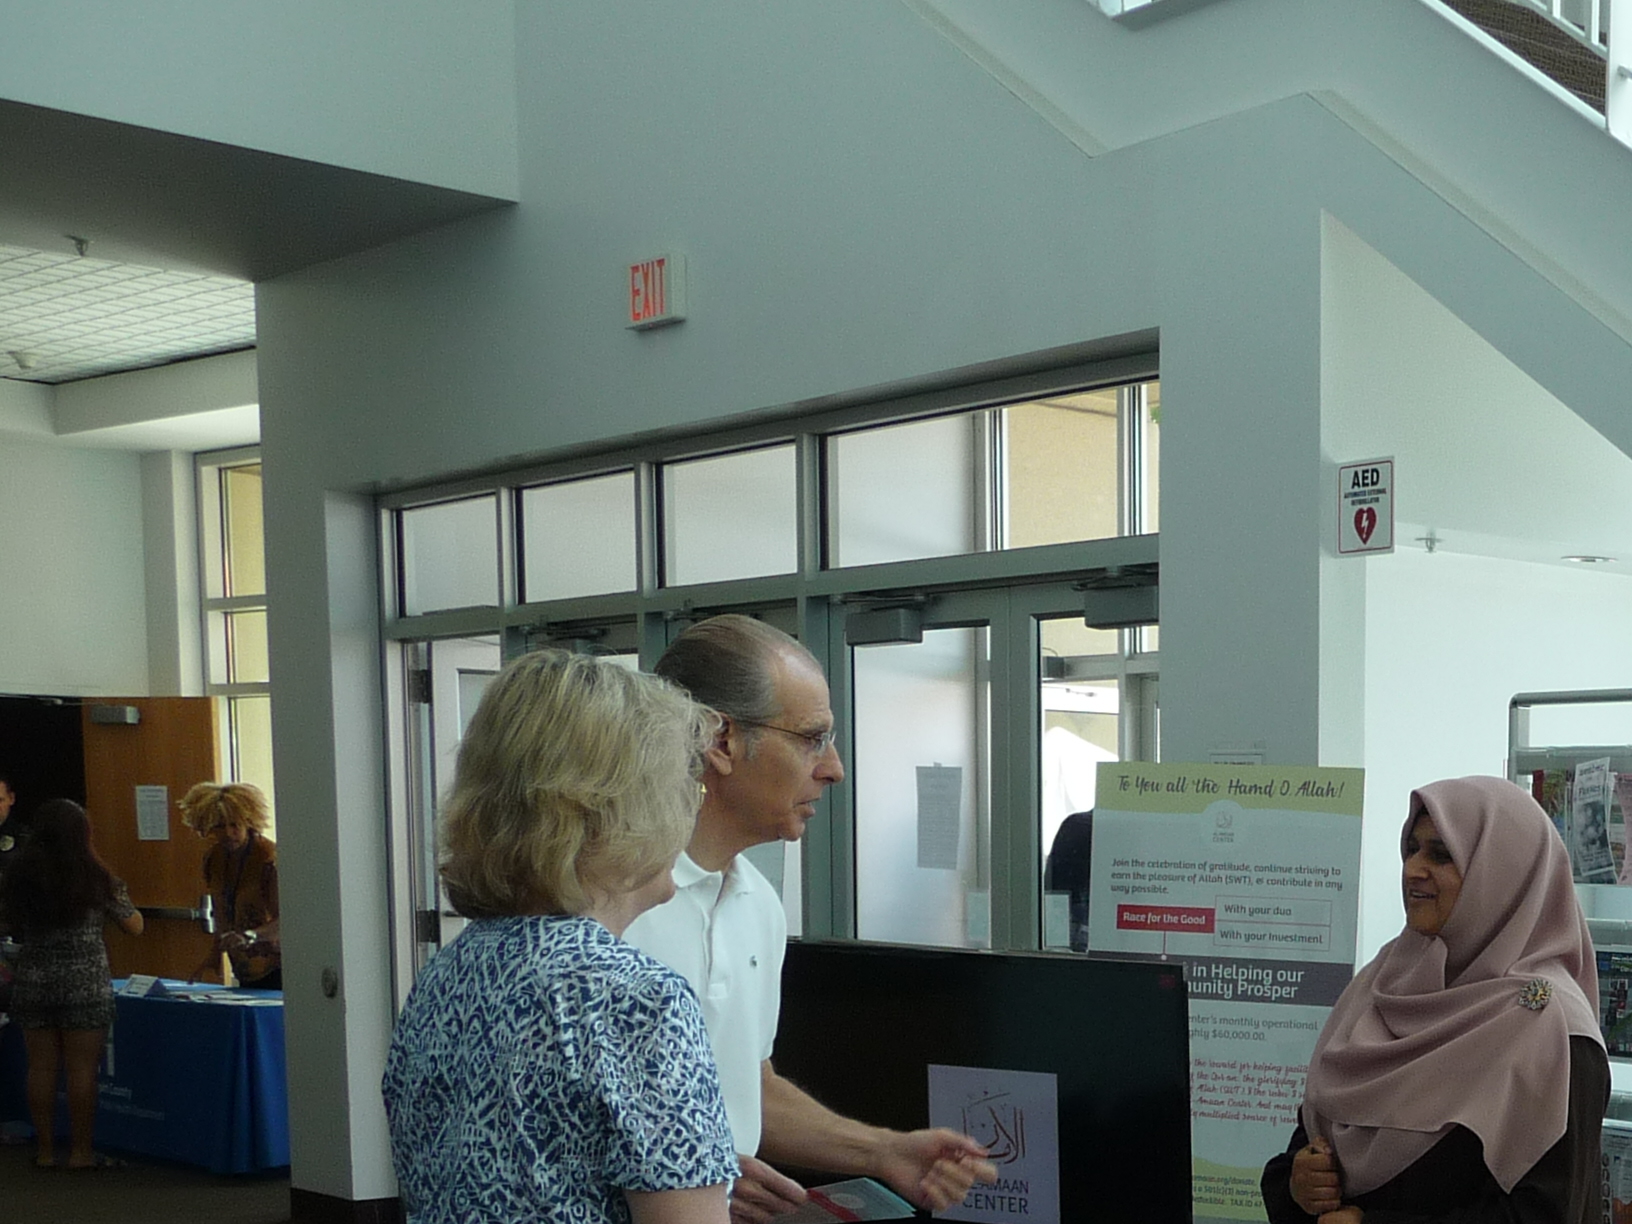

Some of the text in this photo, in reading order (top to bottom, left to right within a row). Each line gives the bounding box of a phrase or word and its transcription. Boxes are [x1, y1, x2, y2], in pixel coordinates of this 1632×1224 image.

[630, 258, 665, 321] EXIT
[1351, 468, 1380, 489] AED
[1118, 775, 1130, 792] To
[1135, 775, 1160, 795] You
[1166, 777, 1186, 794] all
[1191, 777, 1220, 795] the
[1227, 780, 1274, 797] Hamd
[1294, 780, 1345, 798] Allah!
[1112, 858, 1130, 869] Join
[1131, 859, 1146, 869] the
[1147, 860, 1197, 871] celebration
[1198, 861, 1208, 872] of
[1254, 864, 1293, 874] continue
[1295, 865, 1329, 877] striving
[1331, 867, 1342, 877] to
[1111, 873, 1131, 882] earn
[1132, 871, 1147, 881] the
[1148, 873, 1185, 884] pleasure
[1187, 873, 1197, 884] of
[1198, 873, 1224, 884] Allah
[1266, 876, 1313, 888] contribute
[1314, 879, 1323, 888] in
[1325, 881, 1343, 892] any
[1111, 884, 1170, 896] way possible.
[1123, 912, 1206, 925] Race for the Good
[1224, 904, 1247, 914] With
[1248, 906, 1272, 918] your
[1220, 930, 1242, 940] With
[1244, 932, 1267, 943] your
[1192, 962, 1305, 985] in Helping our
[1237, 981, 1299, 1001] Prosper
[1219, 1017, 1260, 1029] monthly
[1261, 1019, 1318, 1032] operational
